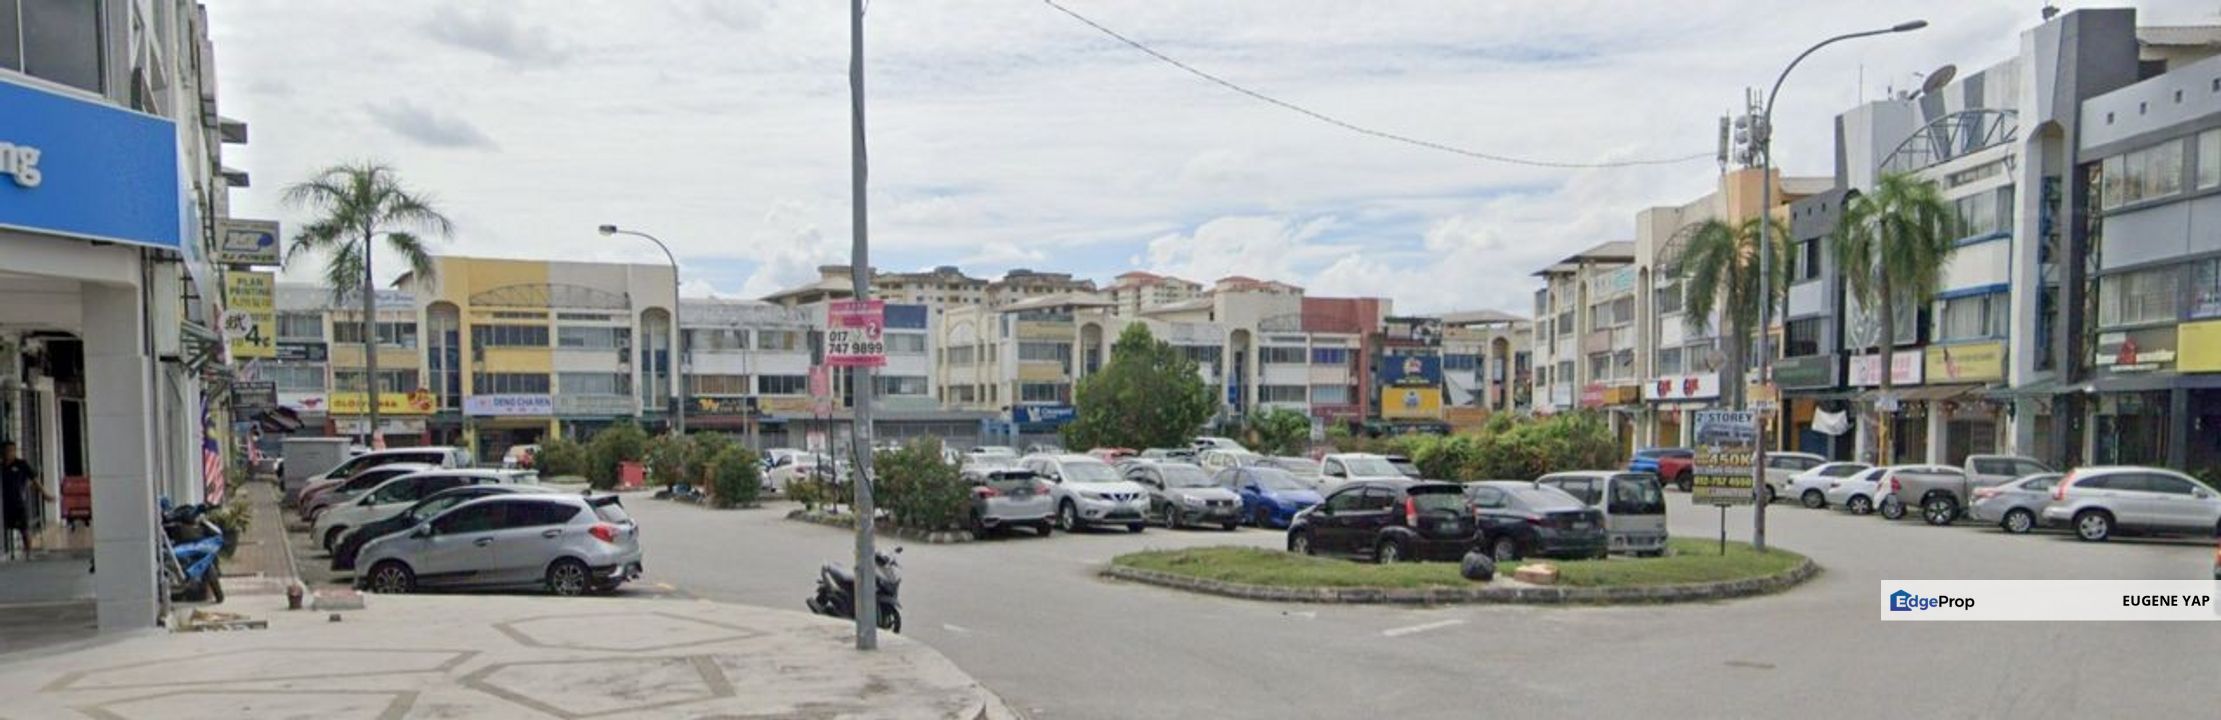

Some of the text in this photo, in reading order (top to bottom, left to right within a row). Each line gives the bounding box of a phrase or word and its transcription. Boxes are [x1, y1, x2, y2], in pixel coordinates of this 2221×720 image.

[237, 277, 263, 286] PLAN
[829, 331, 848, 341] 017
[829, 342, 882, 354] 747 9899
[1697, 413, 1753, 423] 2 STOREY
